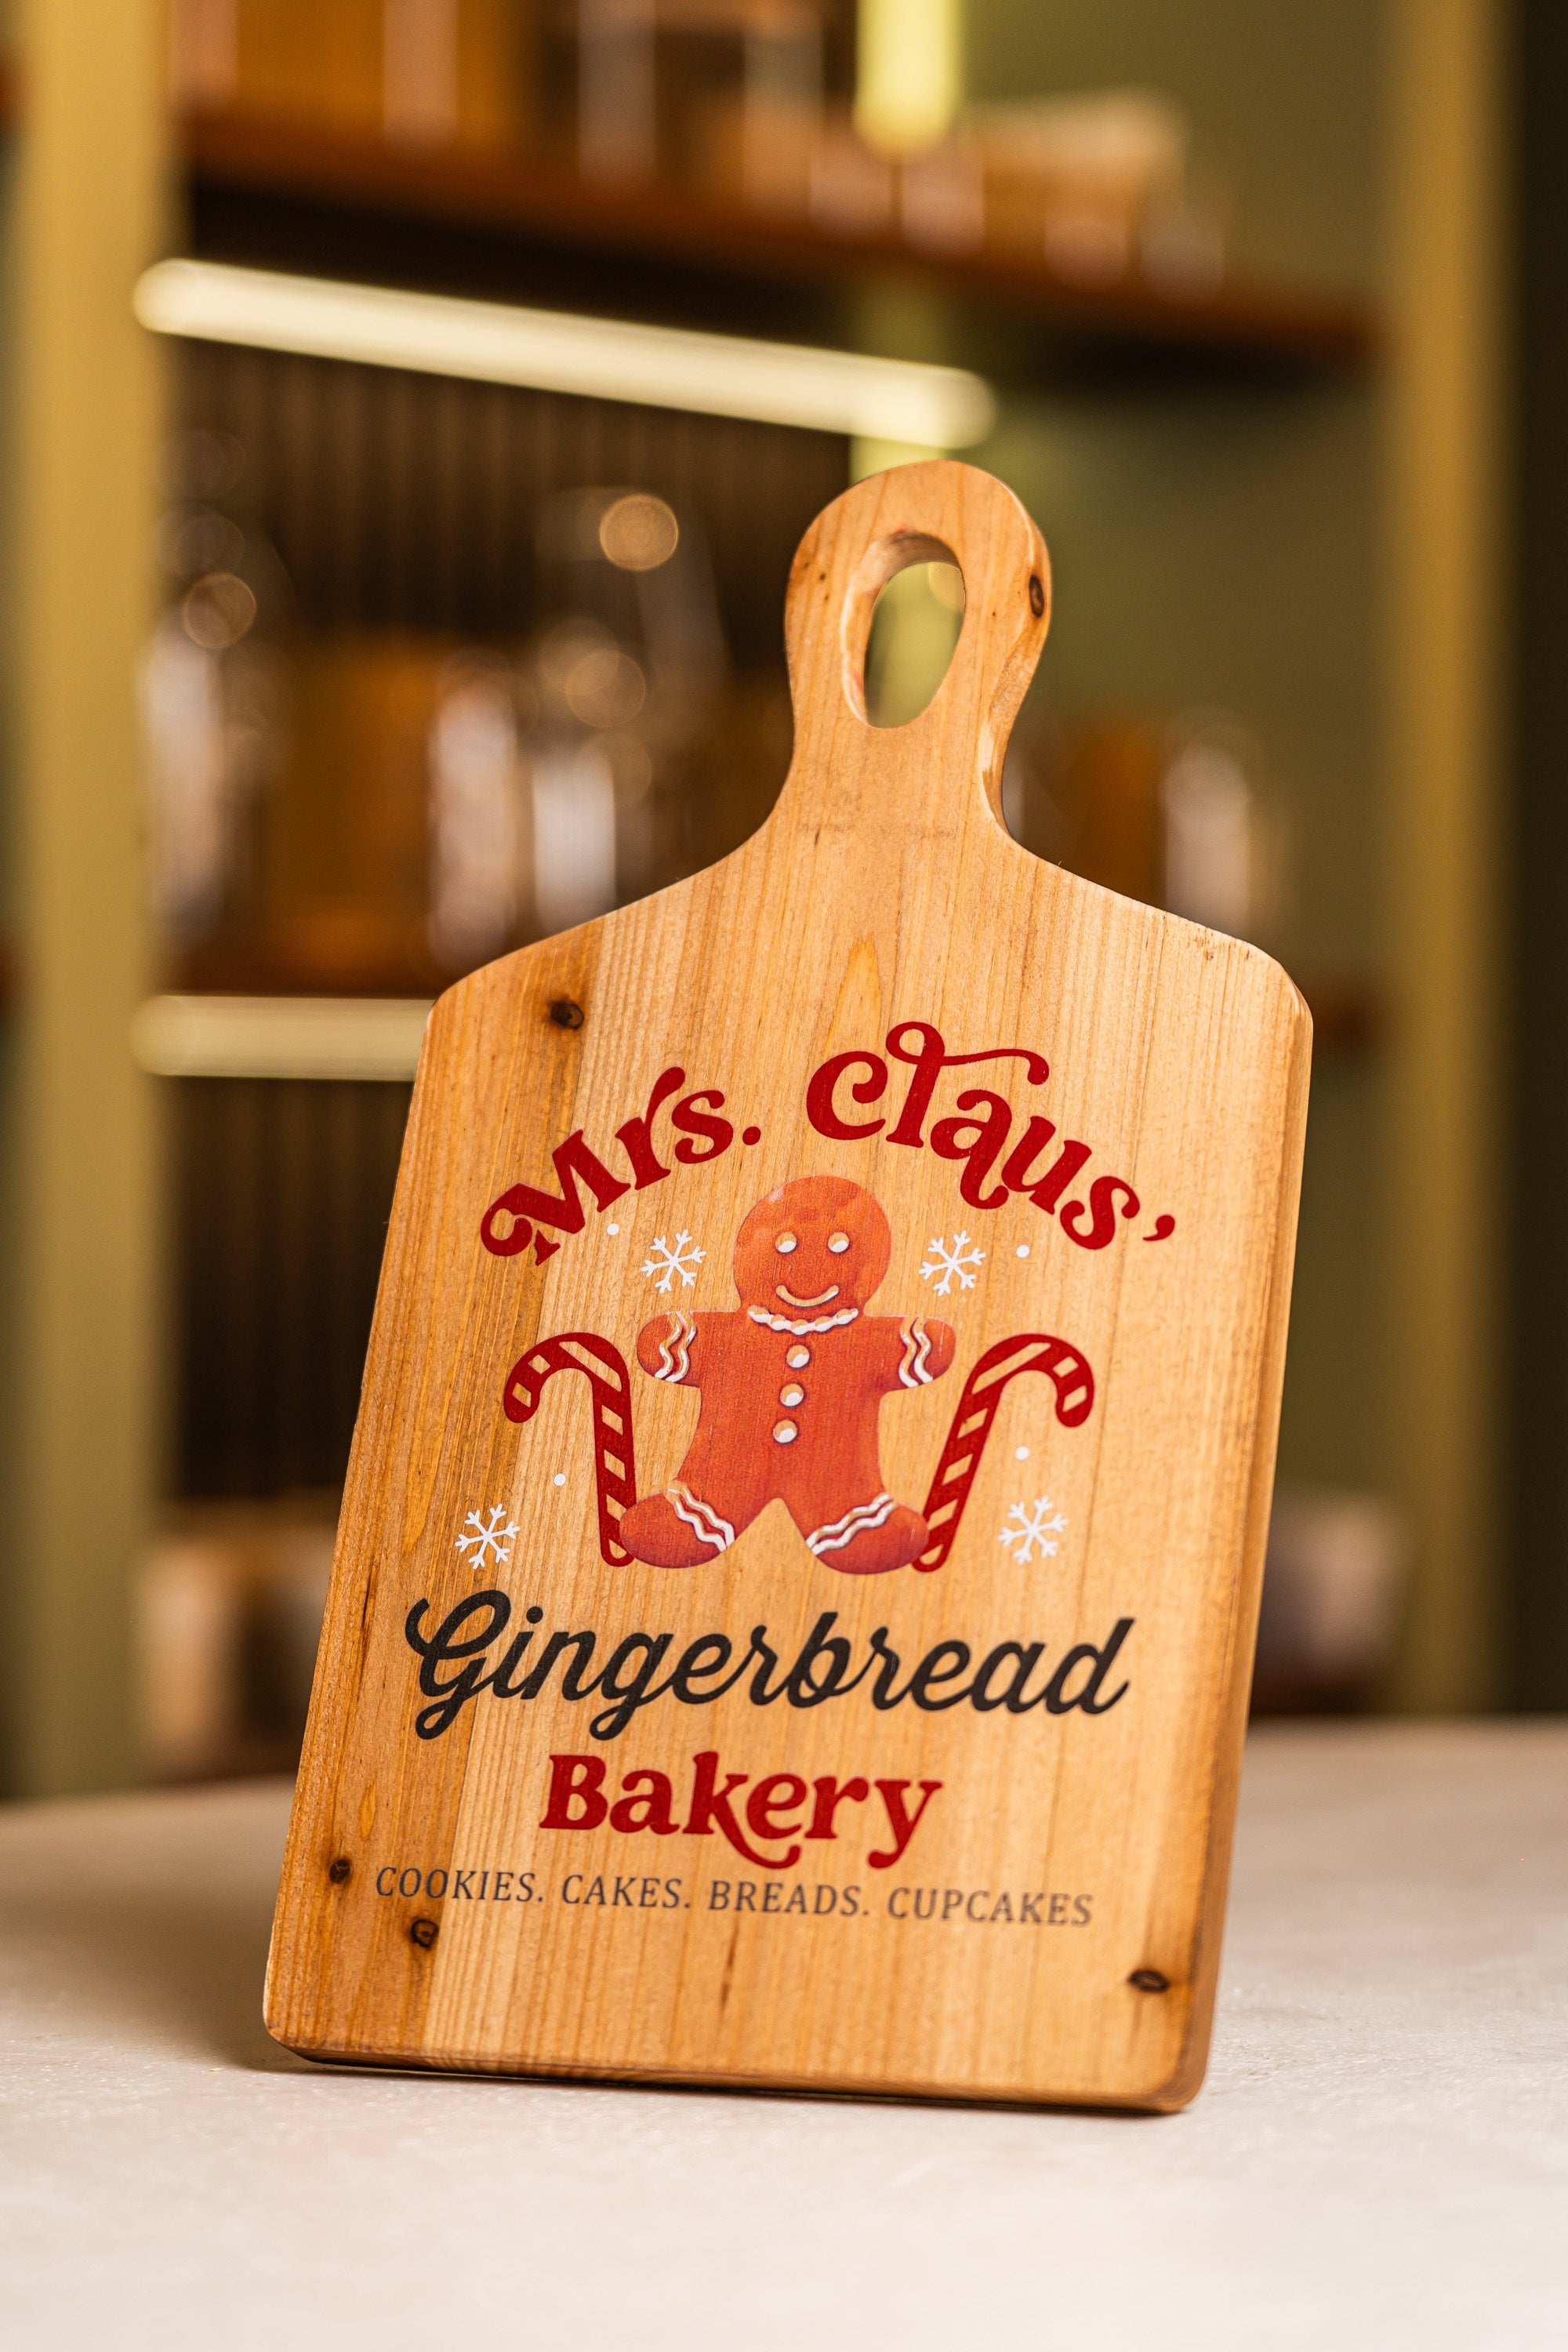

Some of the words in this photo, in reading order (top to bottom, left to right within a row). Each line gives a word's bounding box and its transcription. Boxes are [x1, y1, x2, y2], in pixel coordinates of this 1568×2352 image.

[480, 1066, 761, 1267] Mrs.
[405, 1589, 1134, 1742] Gingerbread
[539, 1751, 942, 1871] Bakery
[376, 1866, 544, 1903] COOKIES.
[562, 1875, 691, 1910] CAKES.
[709, 1880, 870, 1917] BREADS.
[888, 1886, 1094, 1928] CUPCAKES
